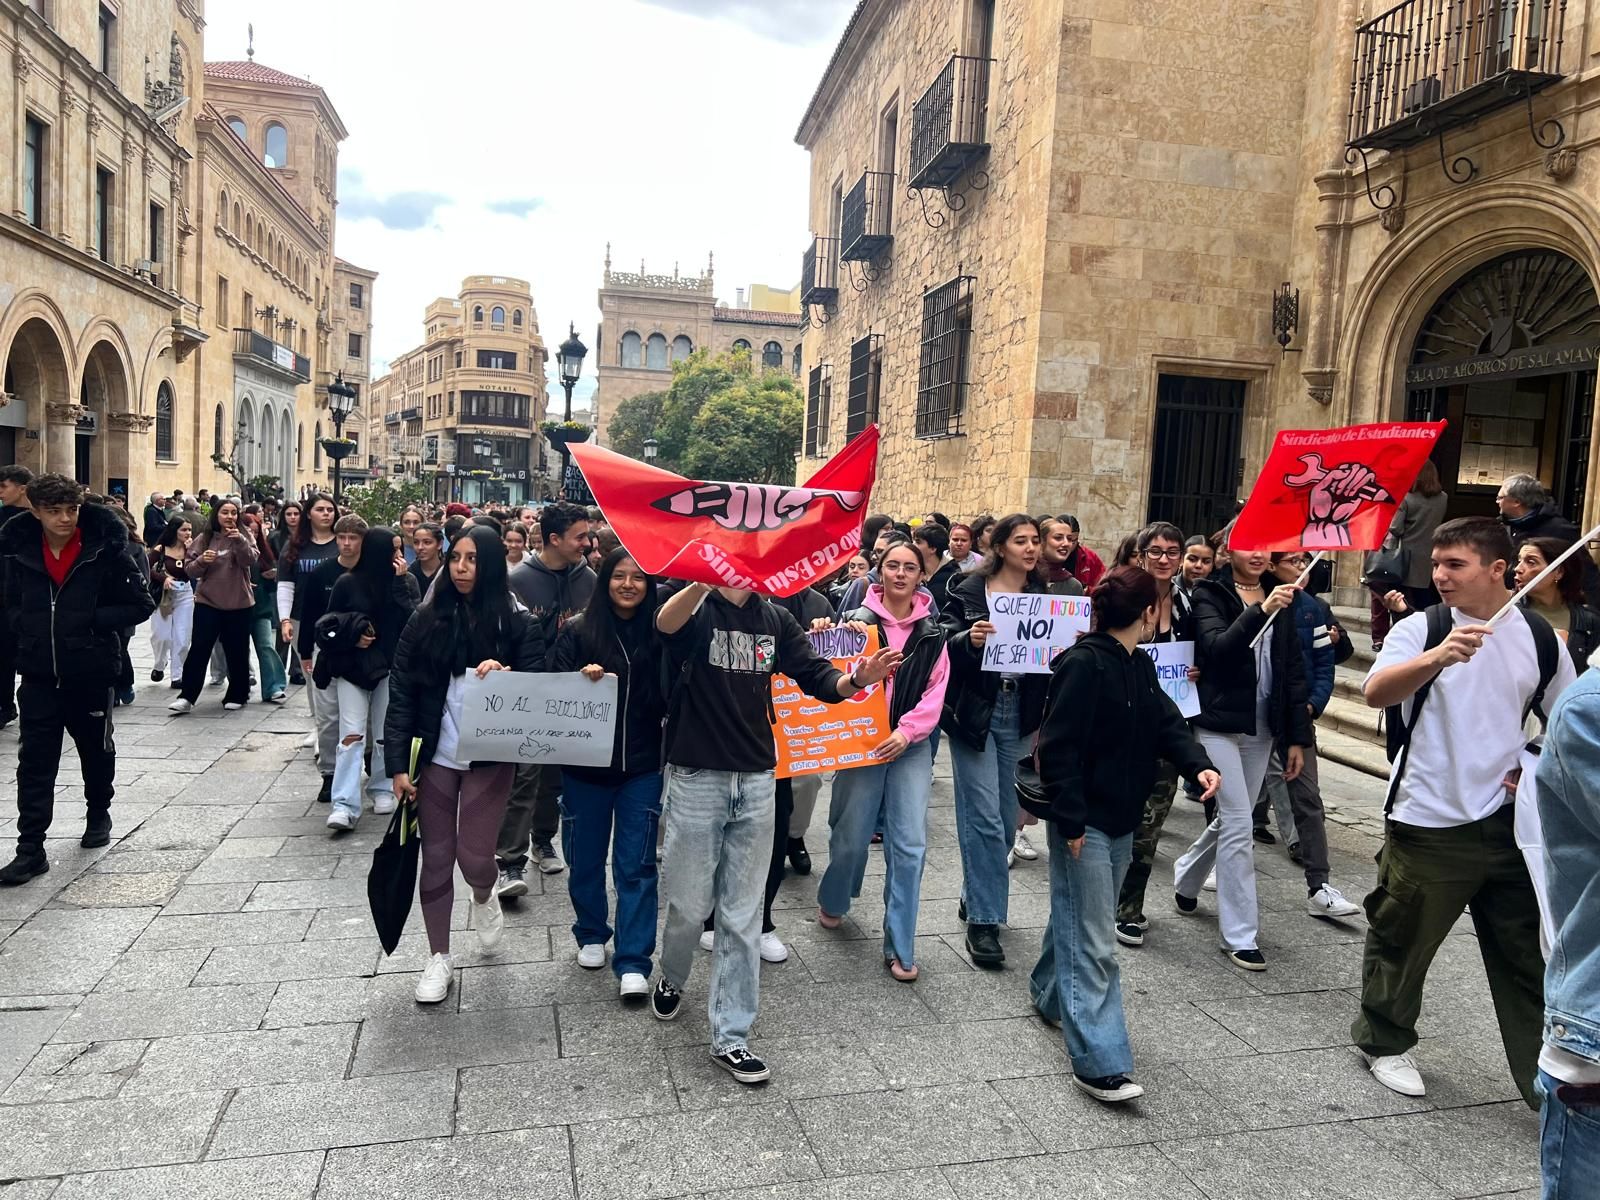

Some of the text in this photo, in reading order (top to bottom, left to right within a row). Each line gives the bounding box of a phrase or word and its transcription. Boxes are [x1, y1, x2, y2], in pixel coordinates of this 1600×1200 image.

[1436, 366, 1451, 380] DE
[1453, 359, 1507, 378] AHORROS
[1509, 355, 1527, 371] DE
[1281, 426, 1437, 446] Sindicato de Estudiantes
[565, 465, 583, 479] BAS
[813, 542, 840, 568] de
[698, 543, 758, 591] Sindi
[763, 556, 817, 593] Estu
[994, 596, 1091, 618] QUE LO INJUSTO
[1017, 618, 1054, 641] NO!
[984, 643, 1008, 666] ME
[1008, 644, 1028, 665] SEA
[484, 694, 504, 712] NO
[511, 696, 532, 713] AL
[791, 761, 819, 771] JUSTICIA
[821, 759, 835, 767] POR
[838, 753, 864, 763] SANDRA
